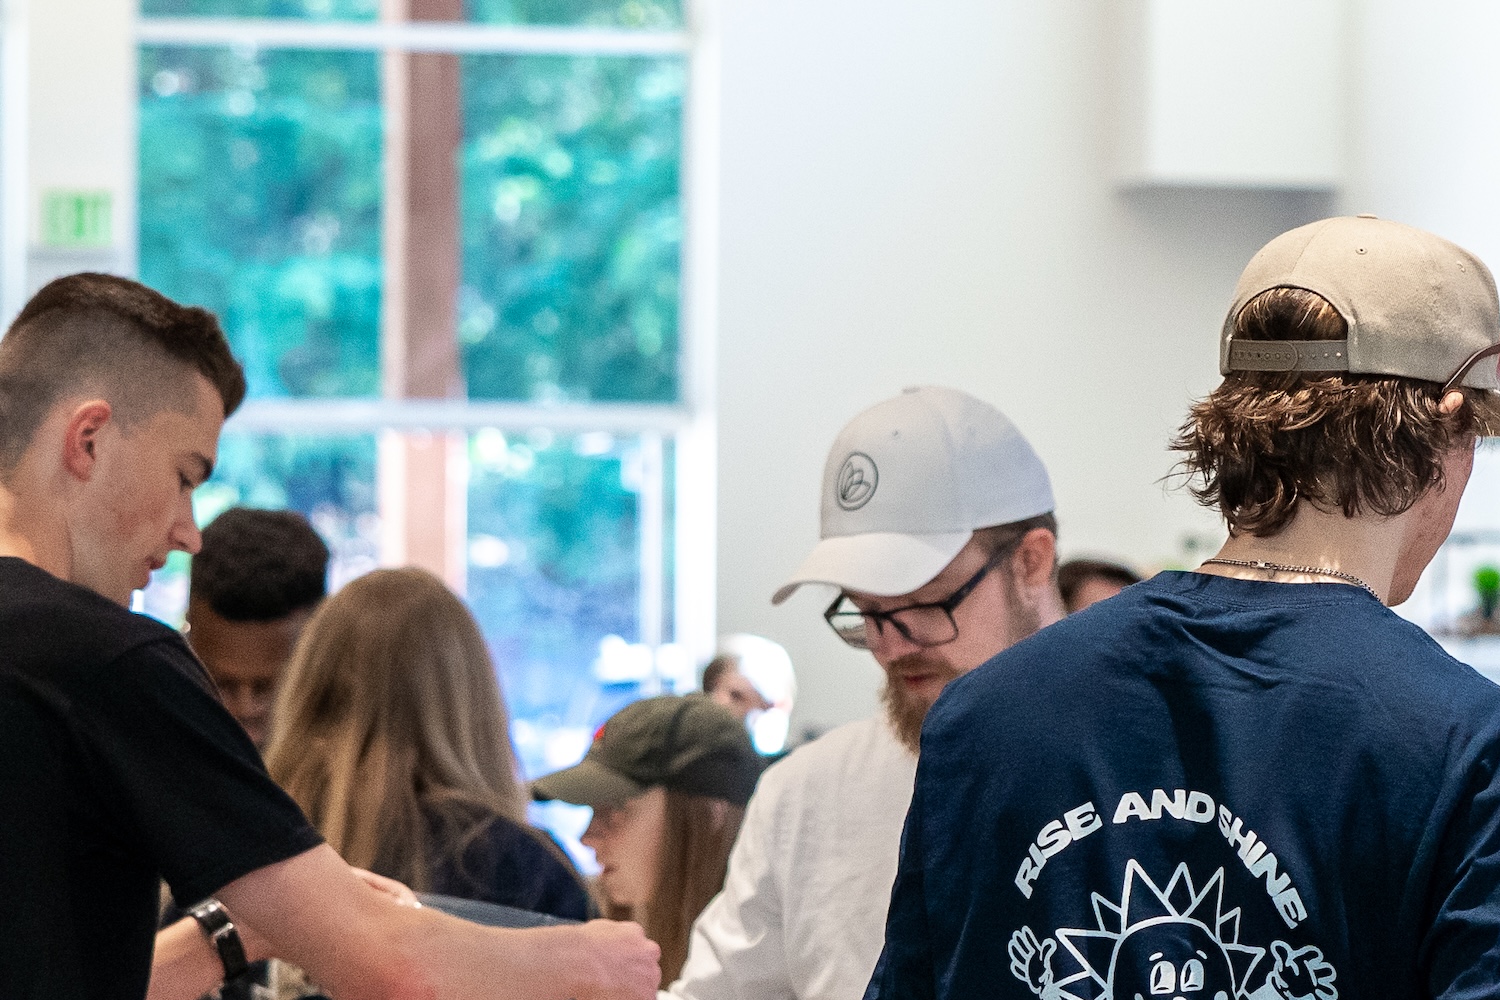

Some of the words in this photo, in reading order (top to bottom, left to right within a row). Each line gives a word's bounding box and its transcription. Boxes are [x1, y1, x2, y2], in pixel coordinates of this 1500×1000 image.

[1014, 801, 1103, 900] RISE
[1112, 789, 1215, 824] AND
[1217, 803, 1308, 930] SHINE
